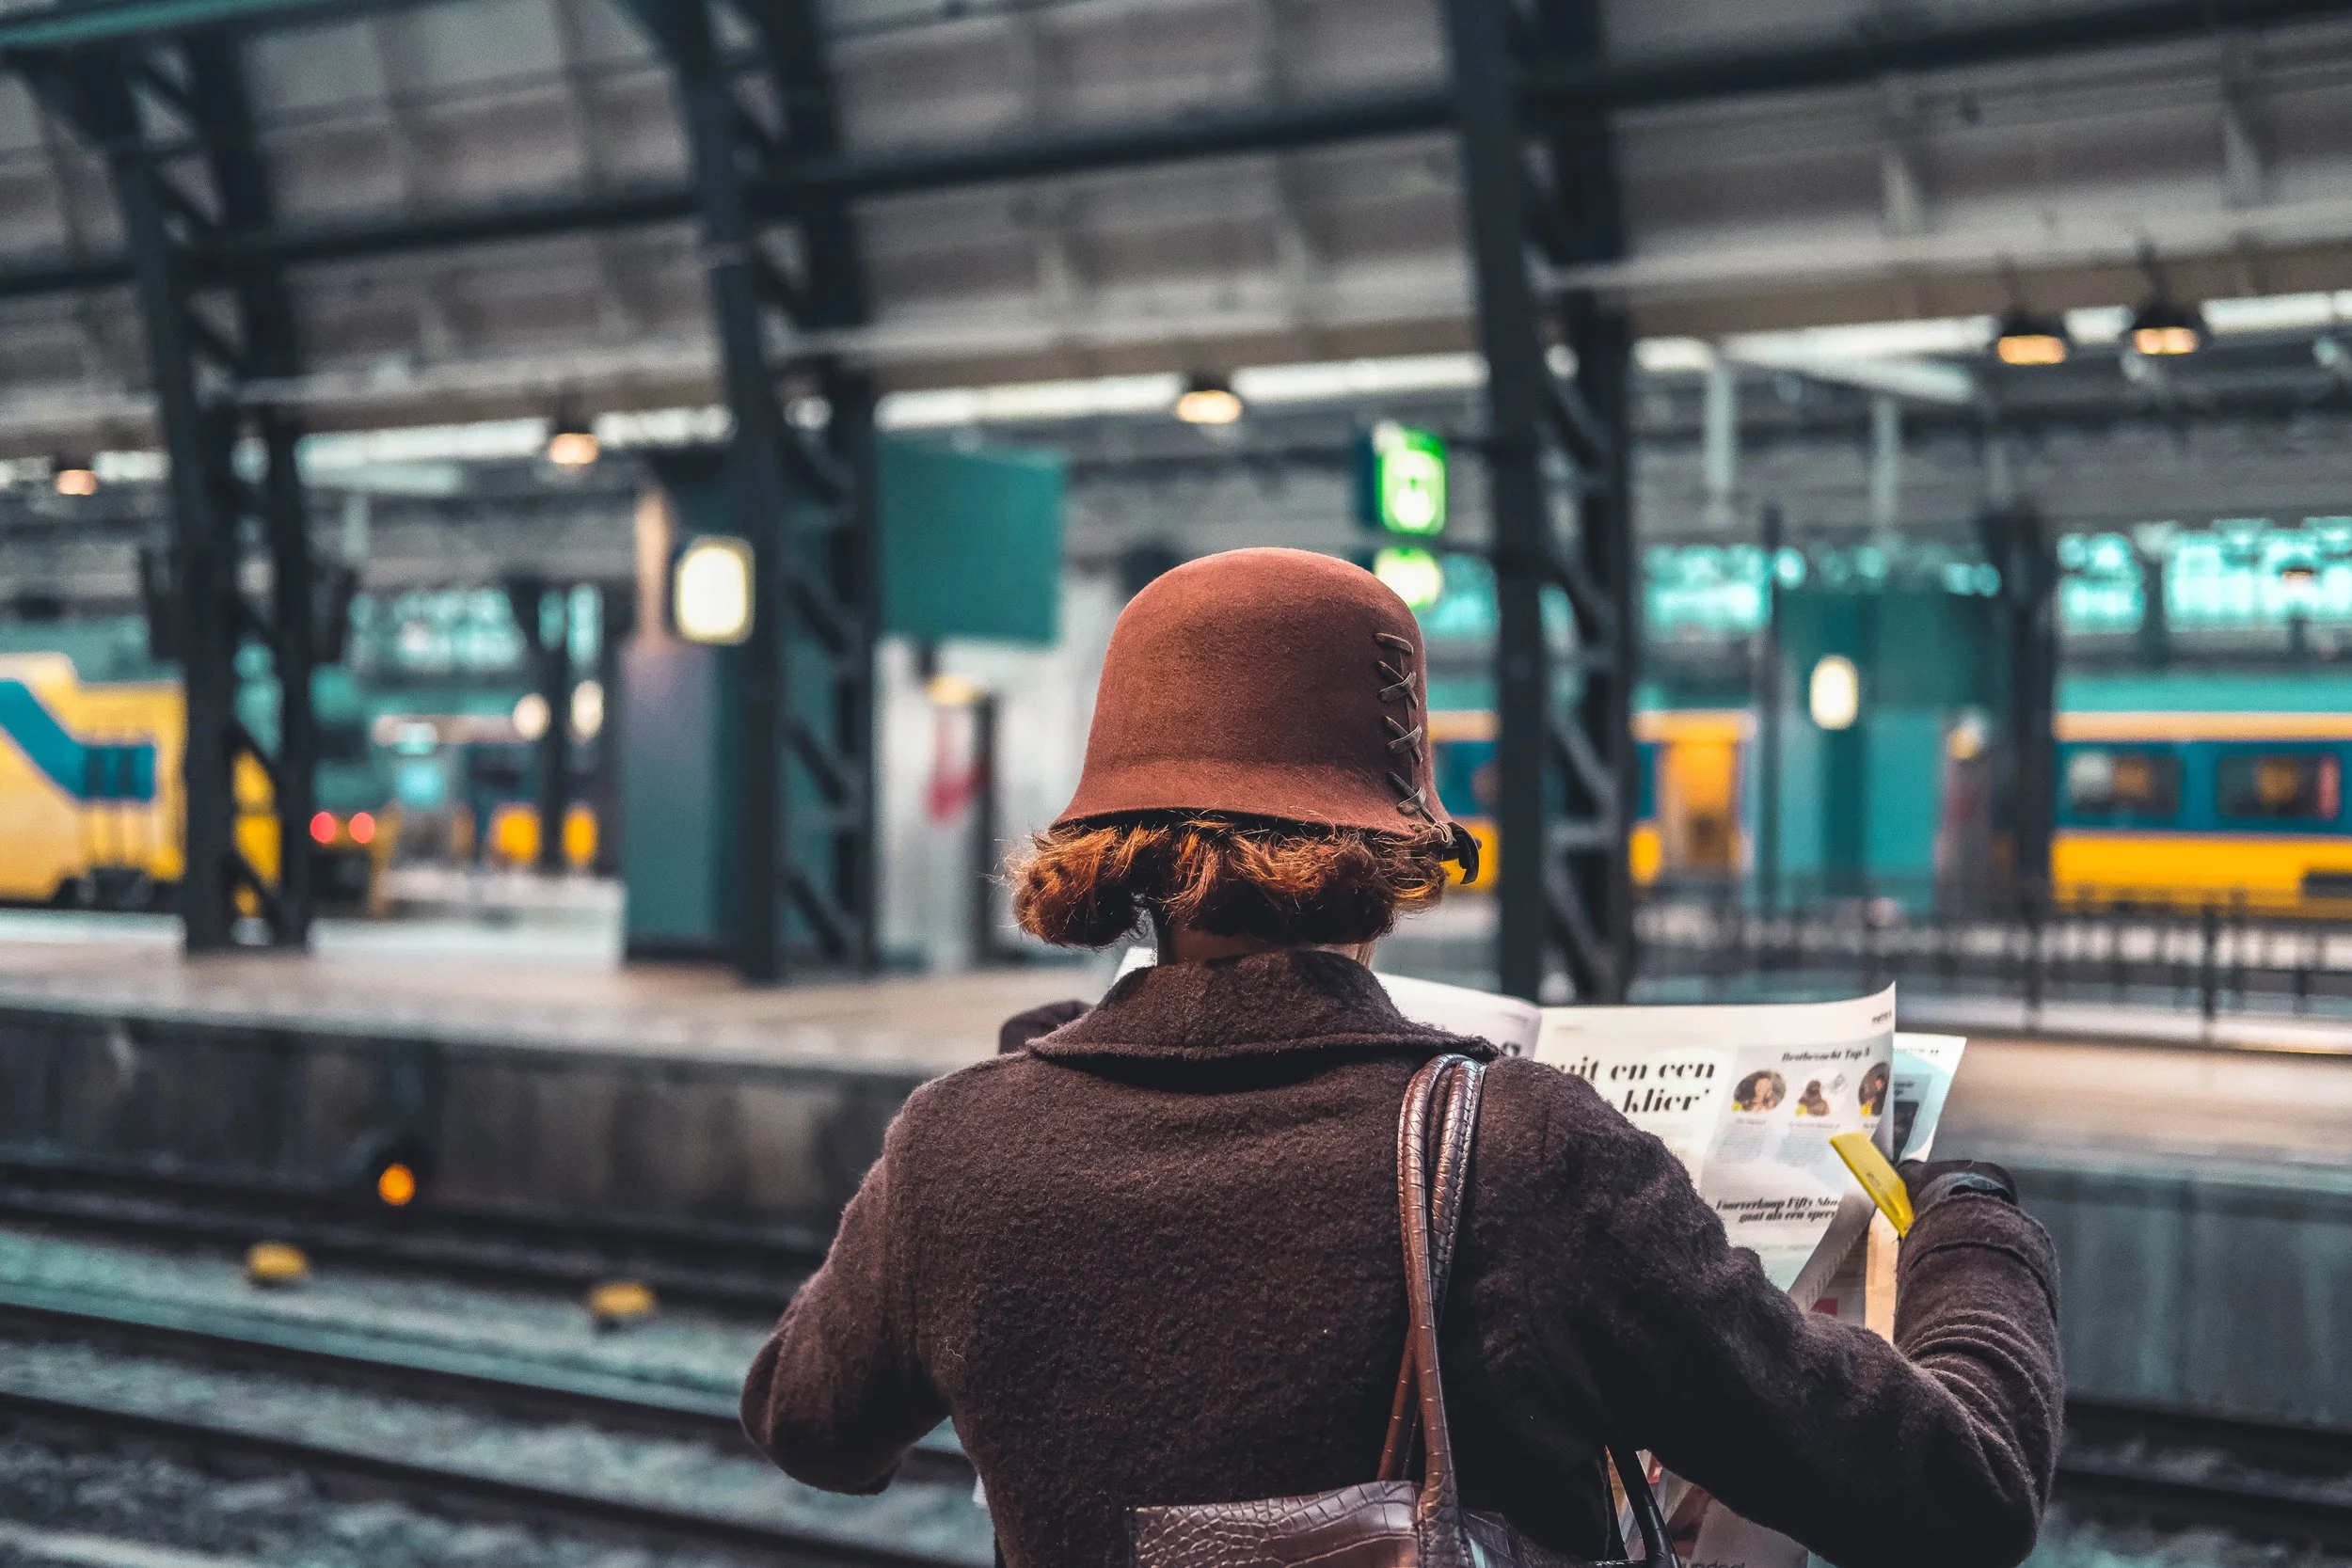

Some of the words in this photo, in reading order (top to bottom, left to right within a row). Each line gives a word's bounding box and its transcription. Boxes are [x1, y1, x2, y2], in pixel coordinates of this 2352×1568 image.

[1609, 1064, 1647, 1081] en
[1658, 1063, 1715, 1079] een
[1787, 1196, 1813, 1211] Fifty
